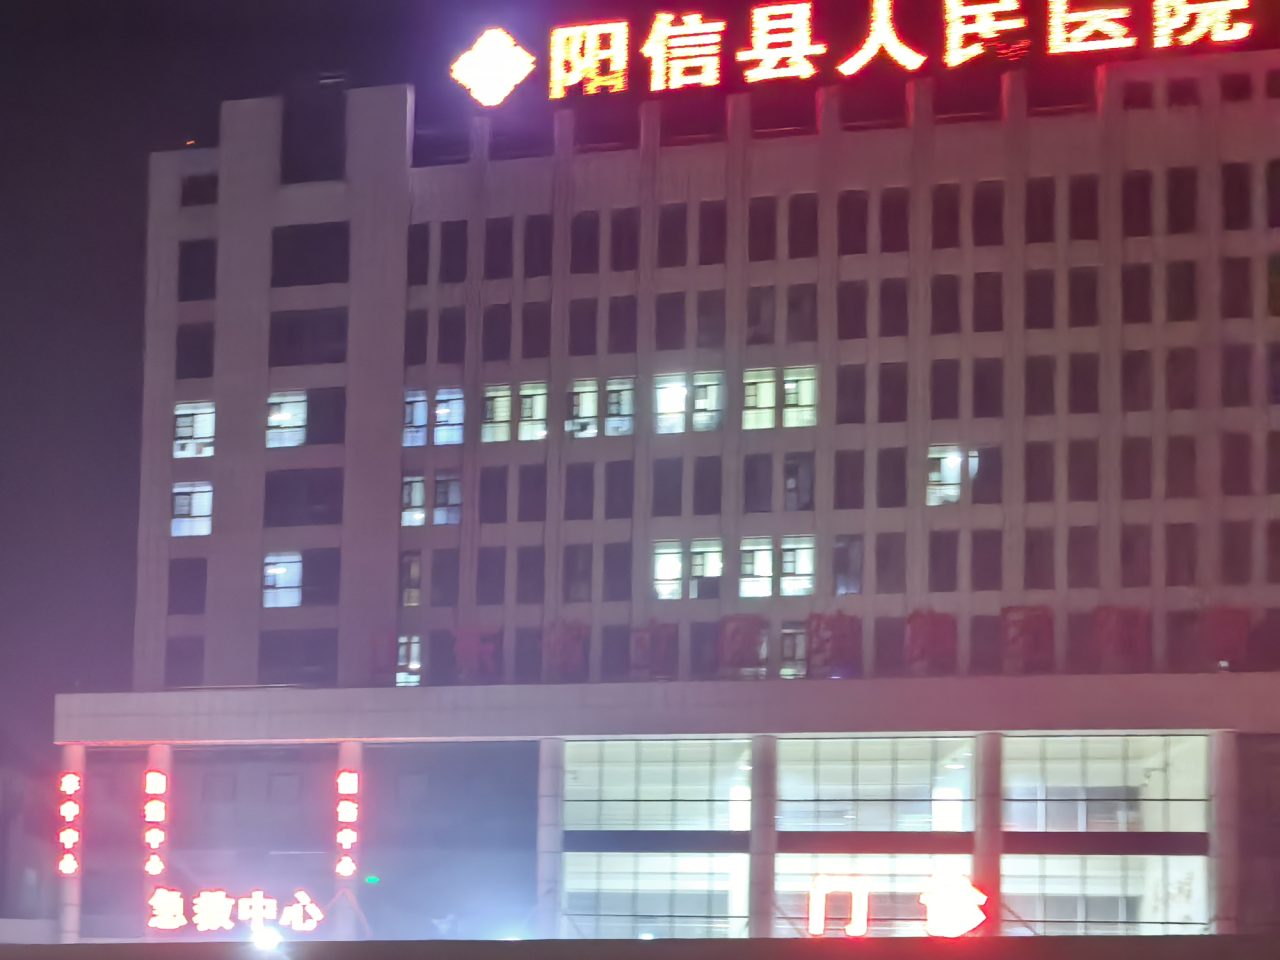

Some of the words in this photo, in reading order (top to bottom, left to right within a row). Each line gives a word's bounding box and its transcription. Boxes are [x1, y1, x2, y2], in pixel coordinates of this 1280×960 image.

[548, 0, 1253, 100] 阳信县人民医院
